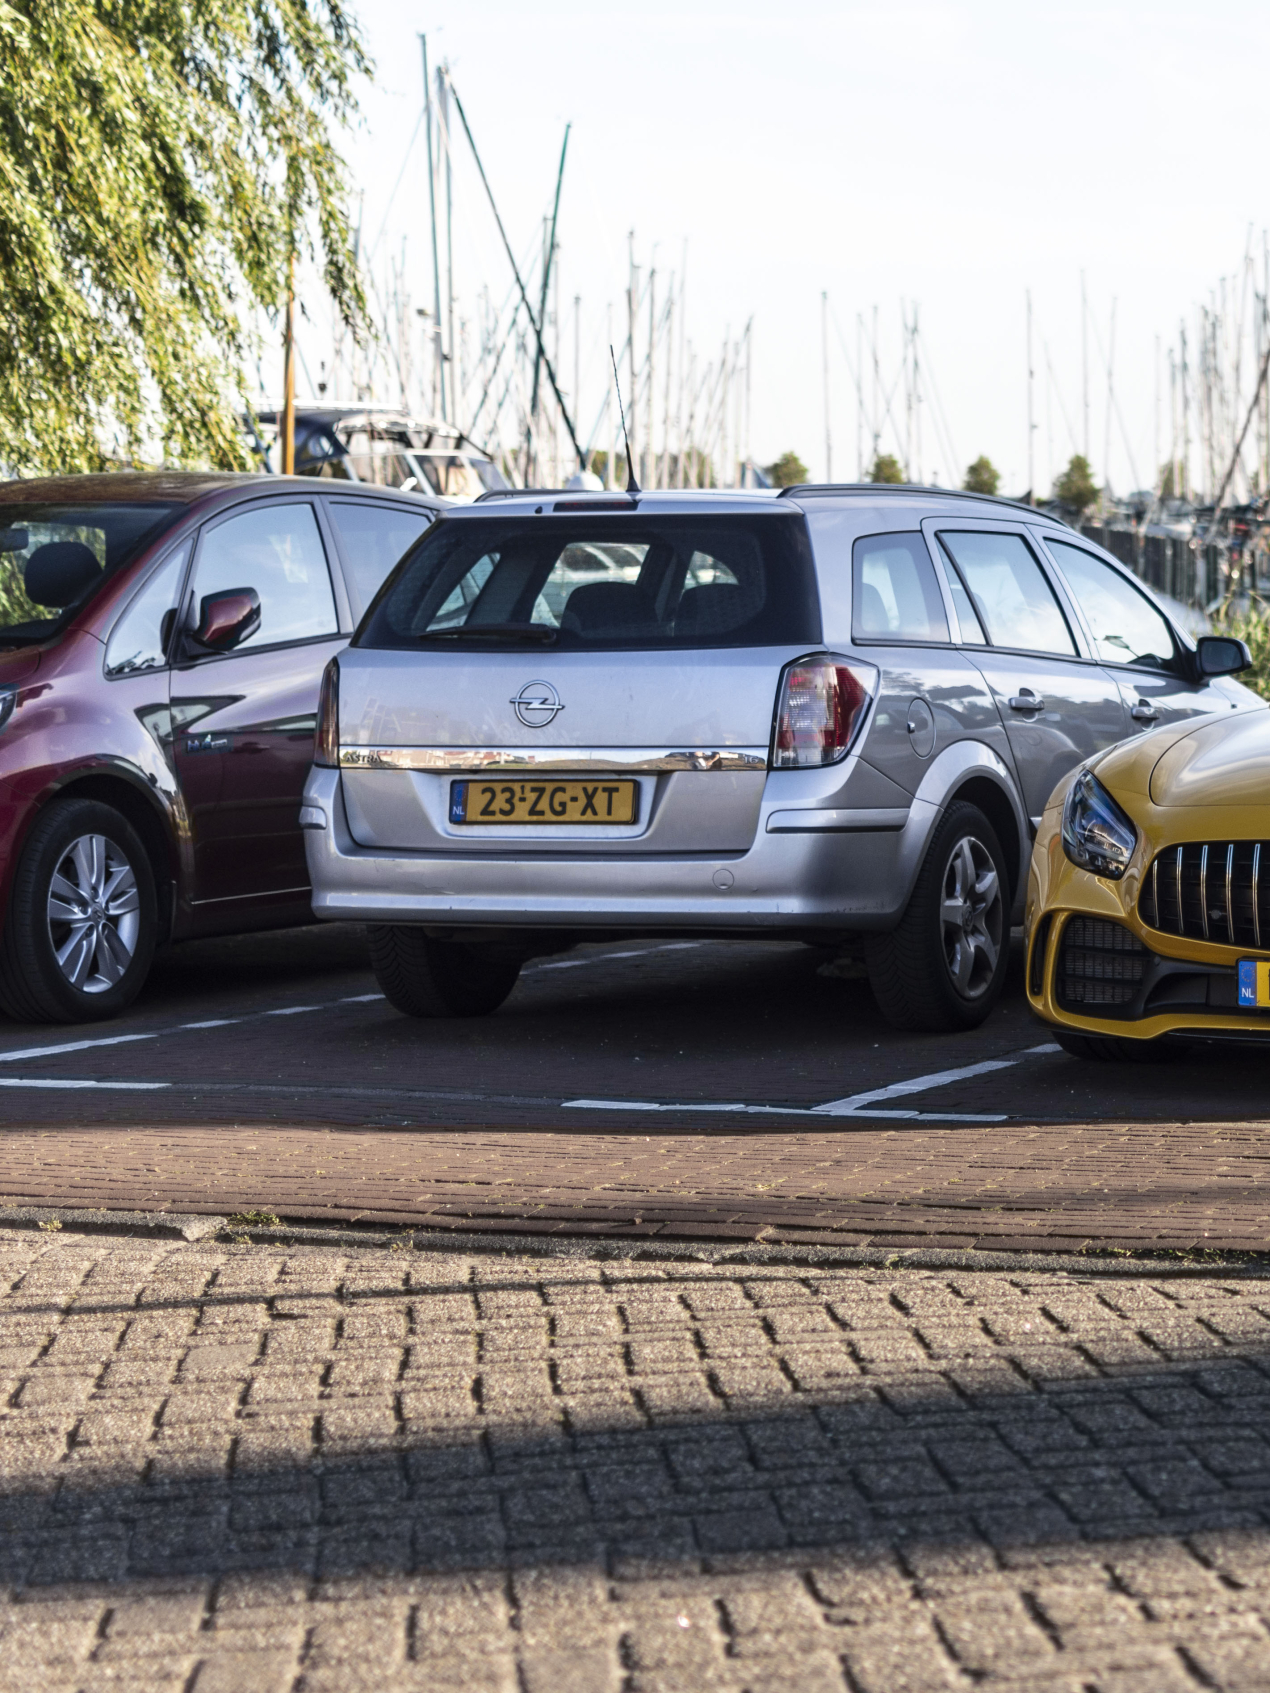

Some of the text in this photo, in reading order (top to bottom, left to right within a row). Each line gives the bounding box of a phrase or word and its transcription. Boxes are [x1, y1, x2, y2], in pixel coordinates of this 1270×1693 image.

[346, 754, 382, 763] ASTRA
[480, 786, 619, 817] 23-ZG-XT
[453, 806, 465, 815] NL
[1241, 987, 1254, 998] NL
